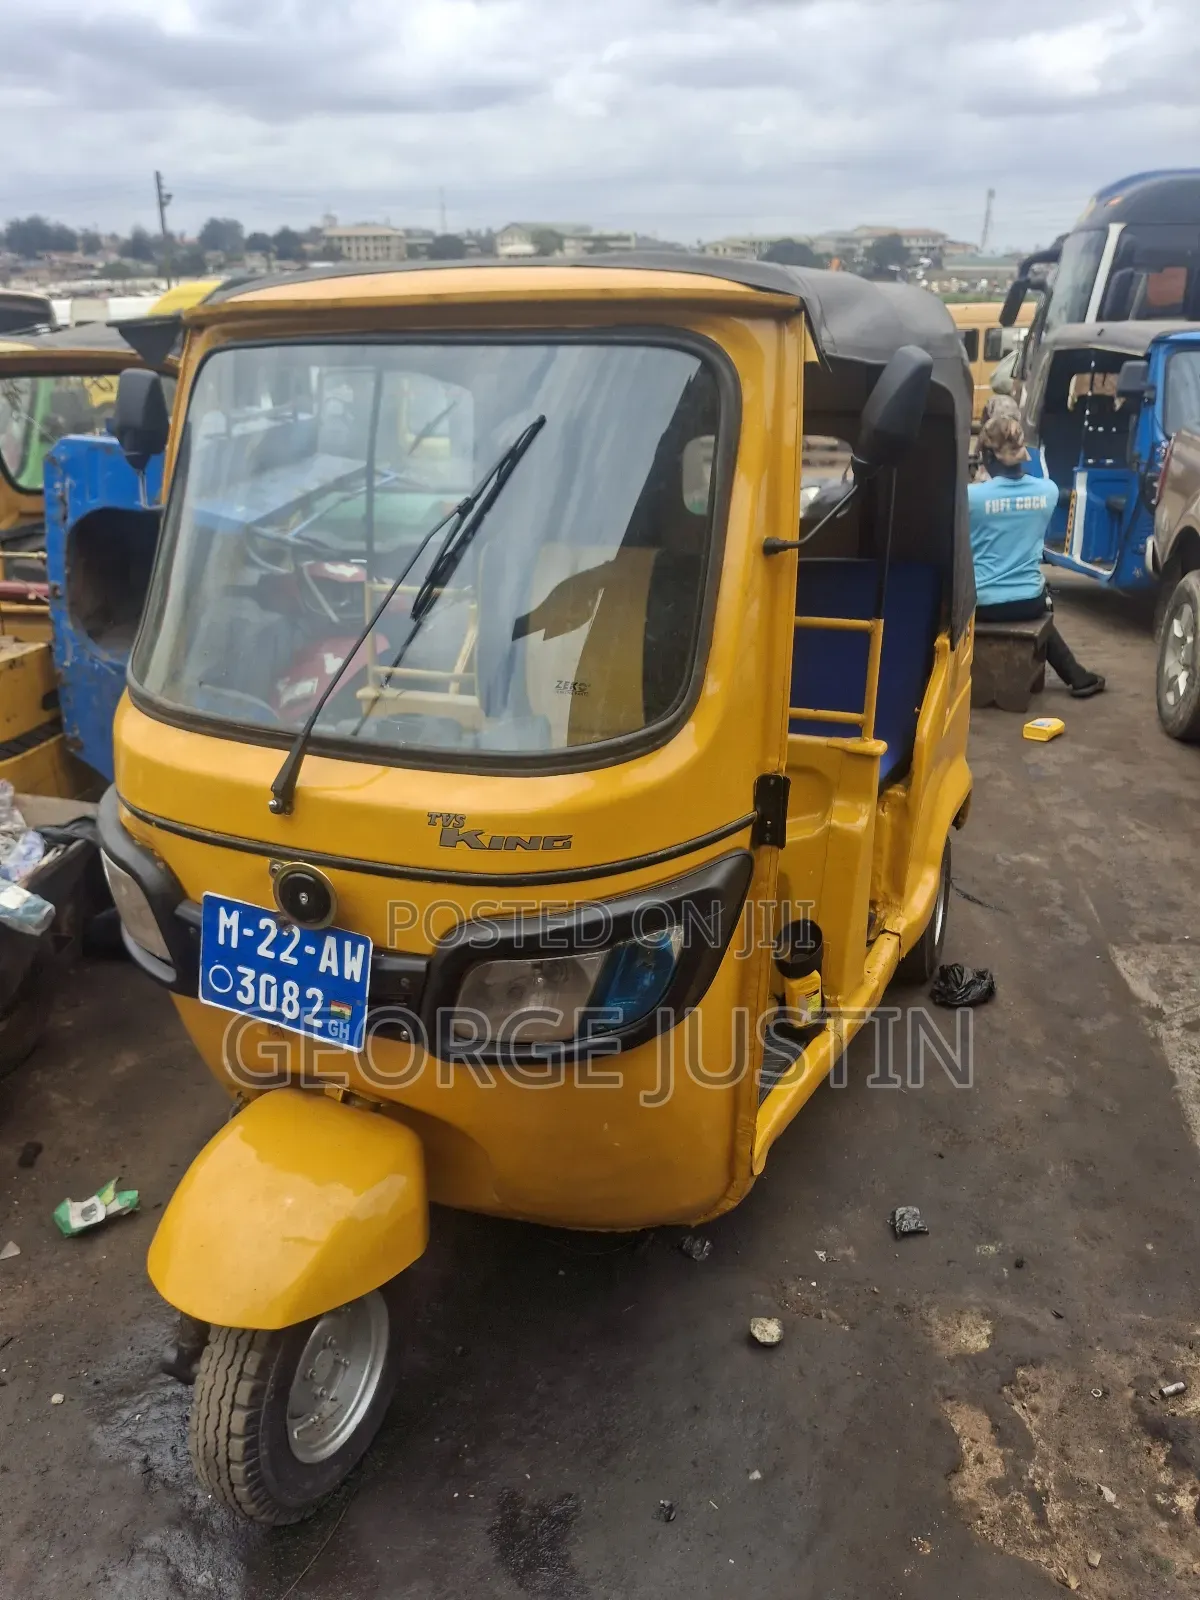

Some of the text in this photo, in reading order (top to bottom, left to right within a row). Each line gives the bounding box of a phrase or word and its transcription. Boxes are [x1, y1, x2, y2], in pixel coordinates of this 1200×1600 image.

[427, 811, 466, 828] TVS
[217, 906, 365, 983] M-22-AW
[236, 965, 324, 1028] 3082
[327, 1019, 351, 1041] GH
